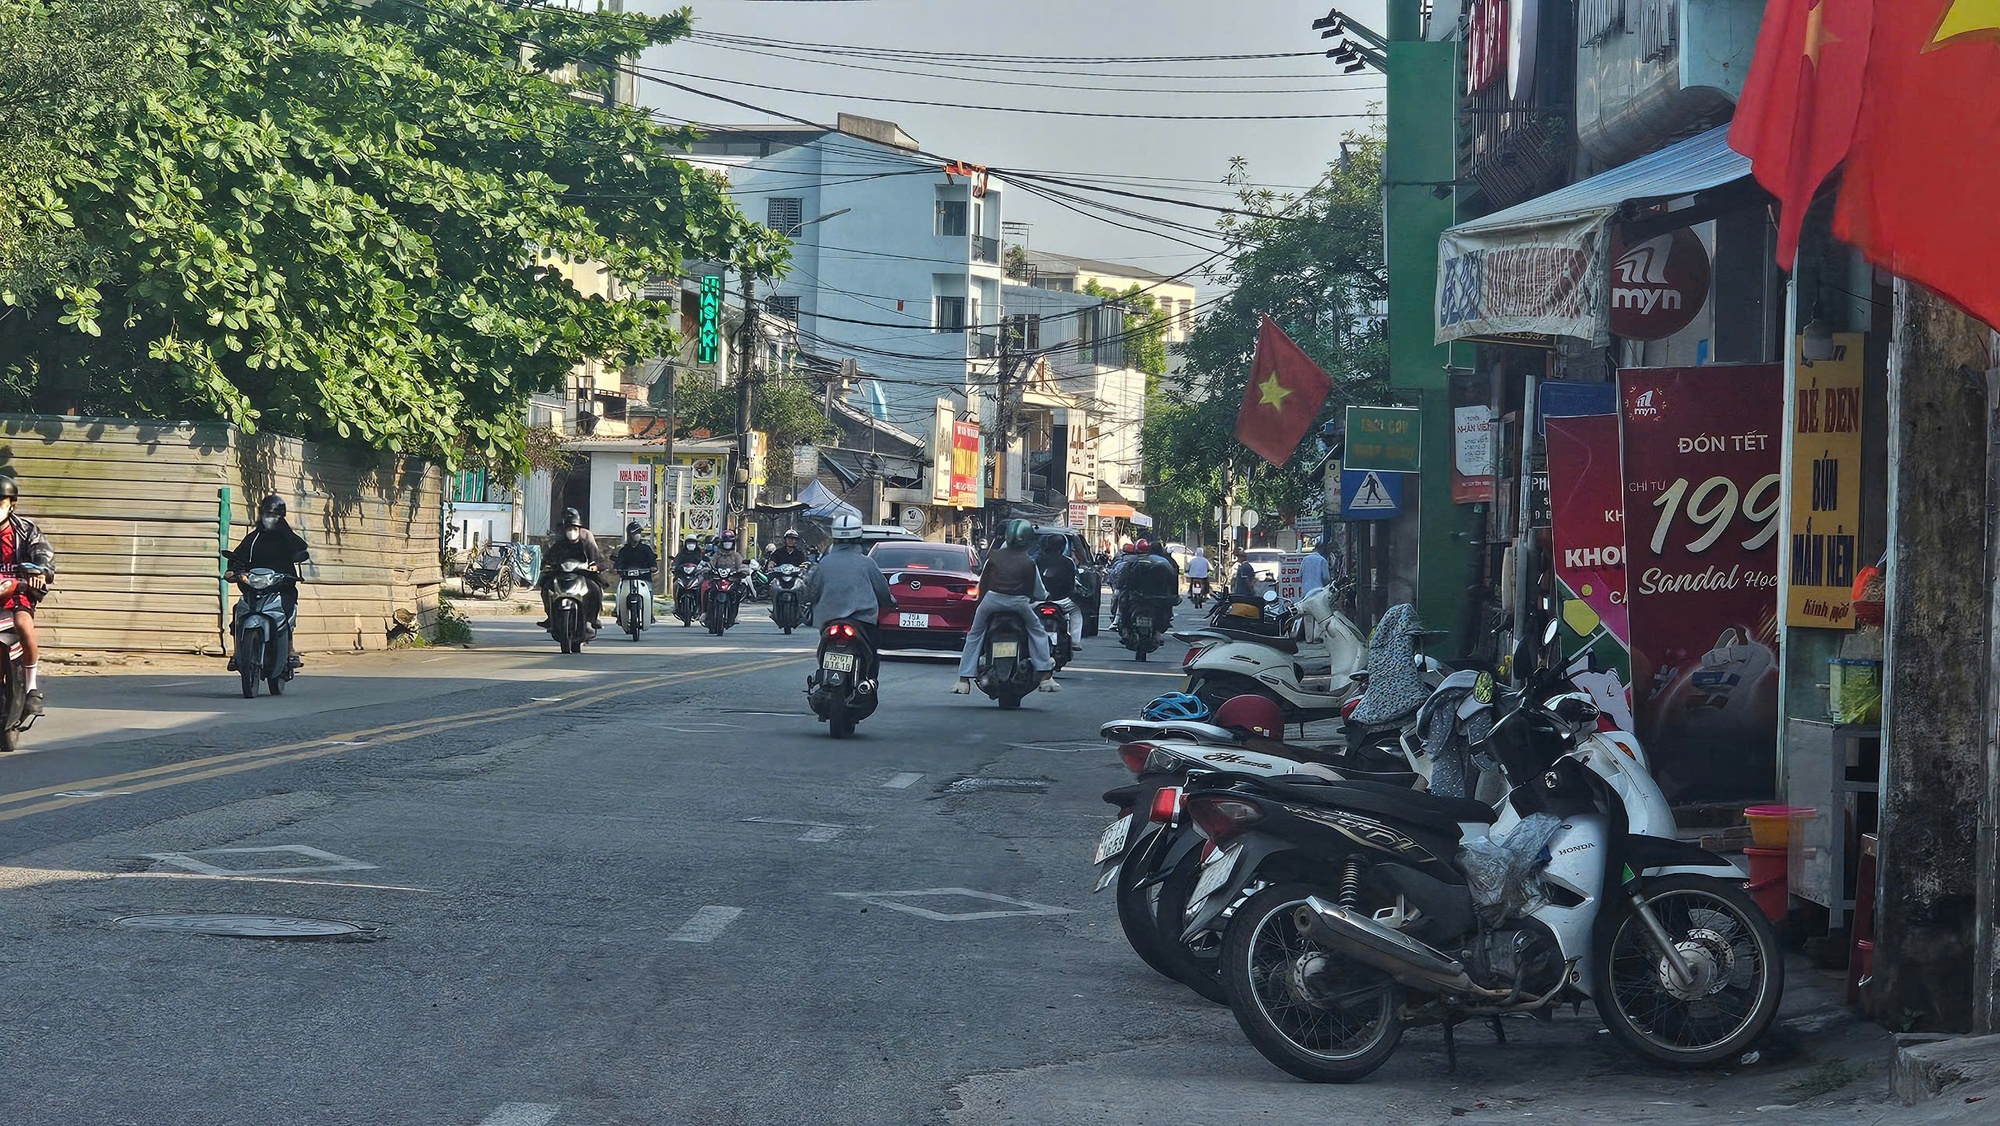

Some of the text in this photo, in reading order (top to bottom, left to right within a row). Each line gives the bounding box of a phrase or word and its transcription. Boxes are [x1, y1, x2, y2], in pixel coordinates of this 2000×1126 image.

[1612, 287, 1682, 315] myn
[702, 278, 716, 361] HASAKI
[1634, 407, 1657, 417] myn
[1677, 429, 1768, 453] ĐÓN TẾT
[1651, 473, 1781, 555] 199
[1565, 545, 1627, 568] KHO
[1638, 564, 1778, 595] Sandal Học
[1559, 842, 1595, 855] HONDA
